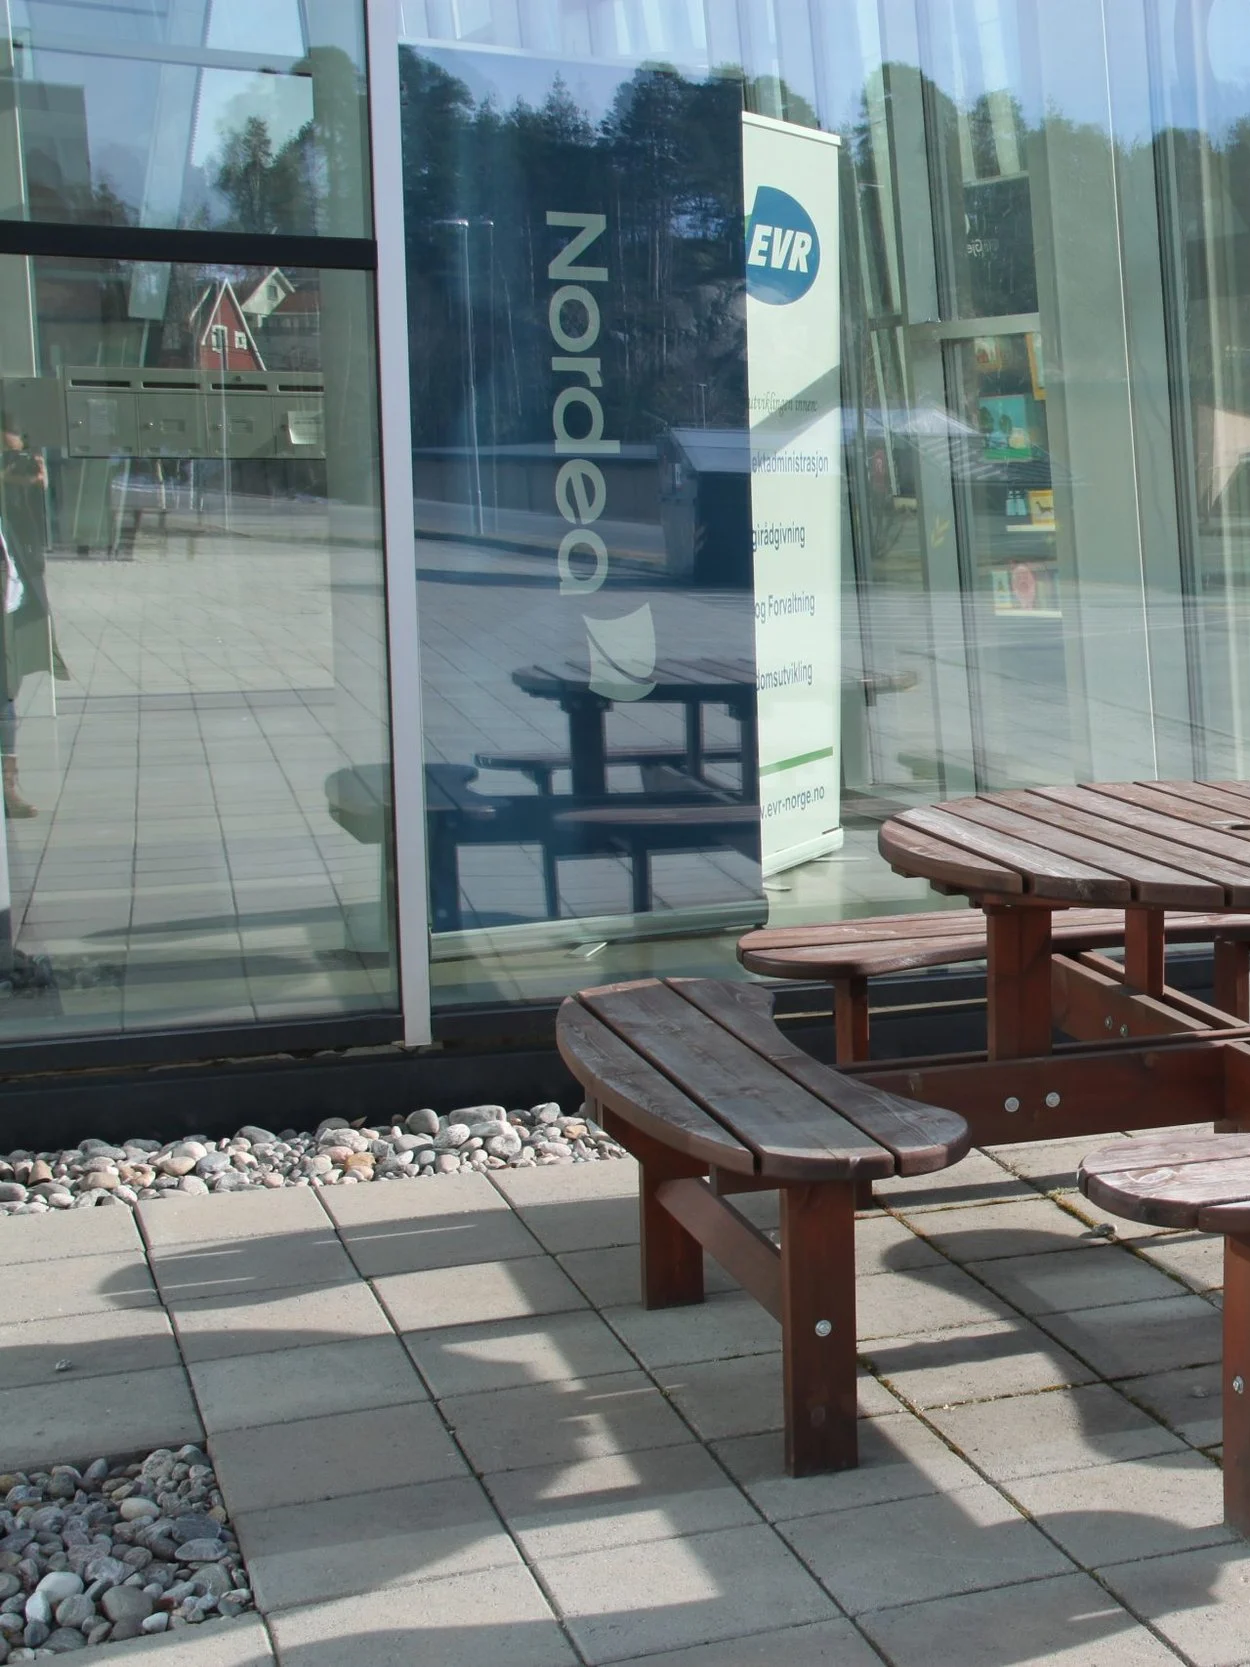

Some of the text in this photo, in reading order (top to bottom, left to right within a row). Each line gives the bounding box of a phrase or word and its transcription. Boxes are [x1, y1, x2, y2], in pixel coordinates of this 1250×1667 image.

[747, 223, 813, 274] EVR
[545, 211, 621, 596] Nordea
[755, 592, 815, 624] og Forvaltning
